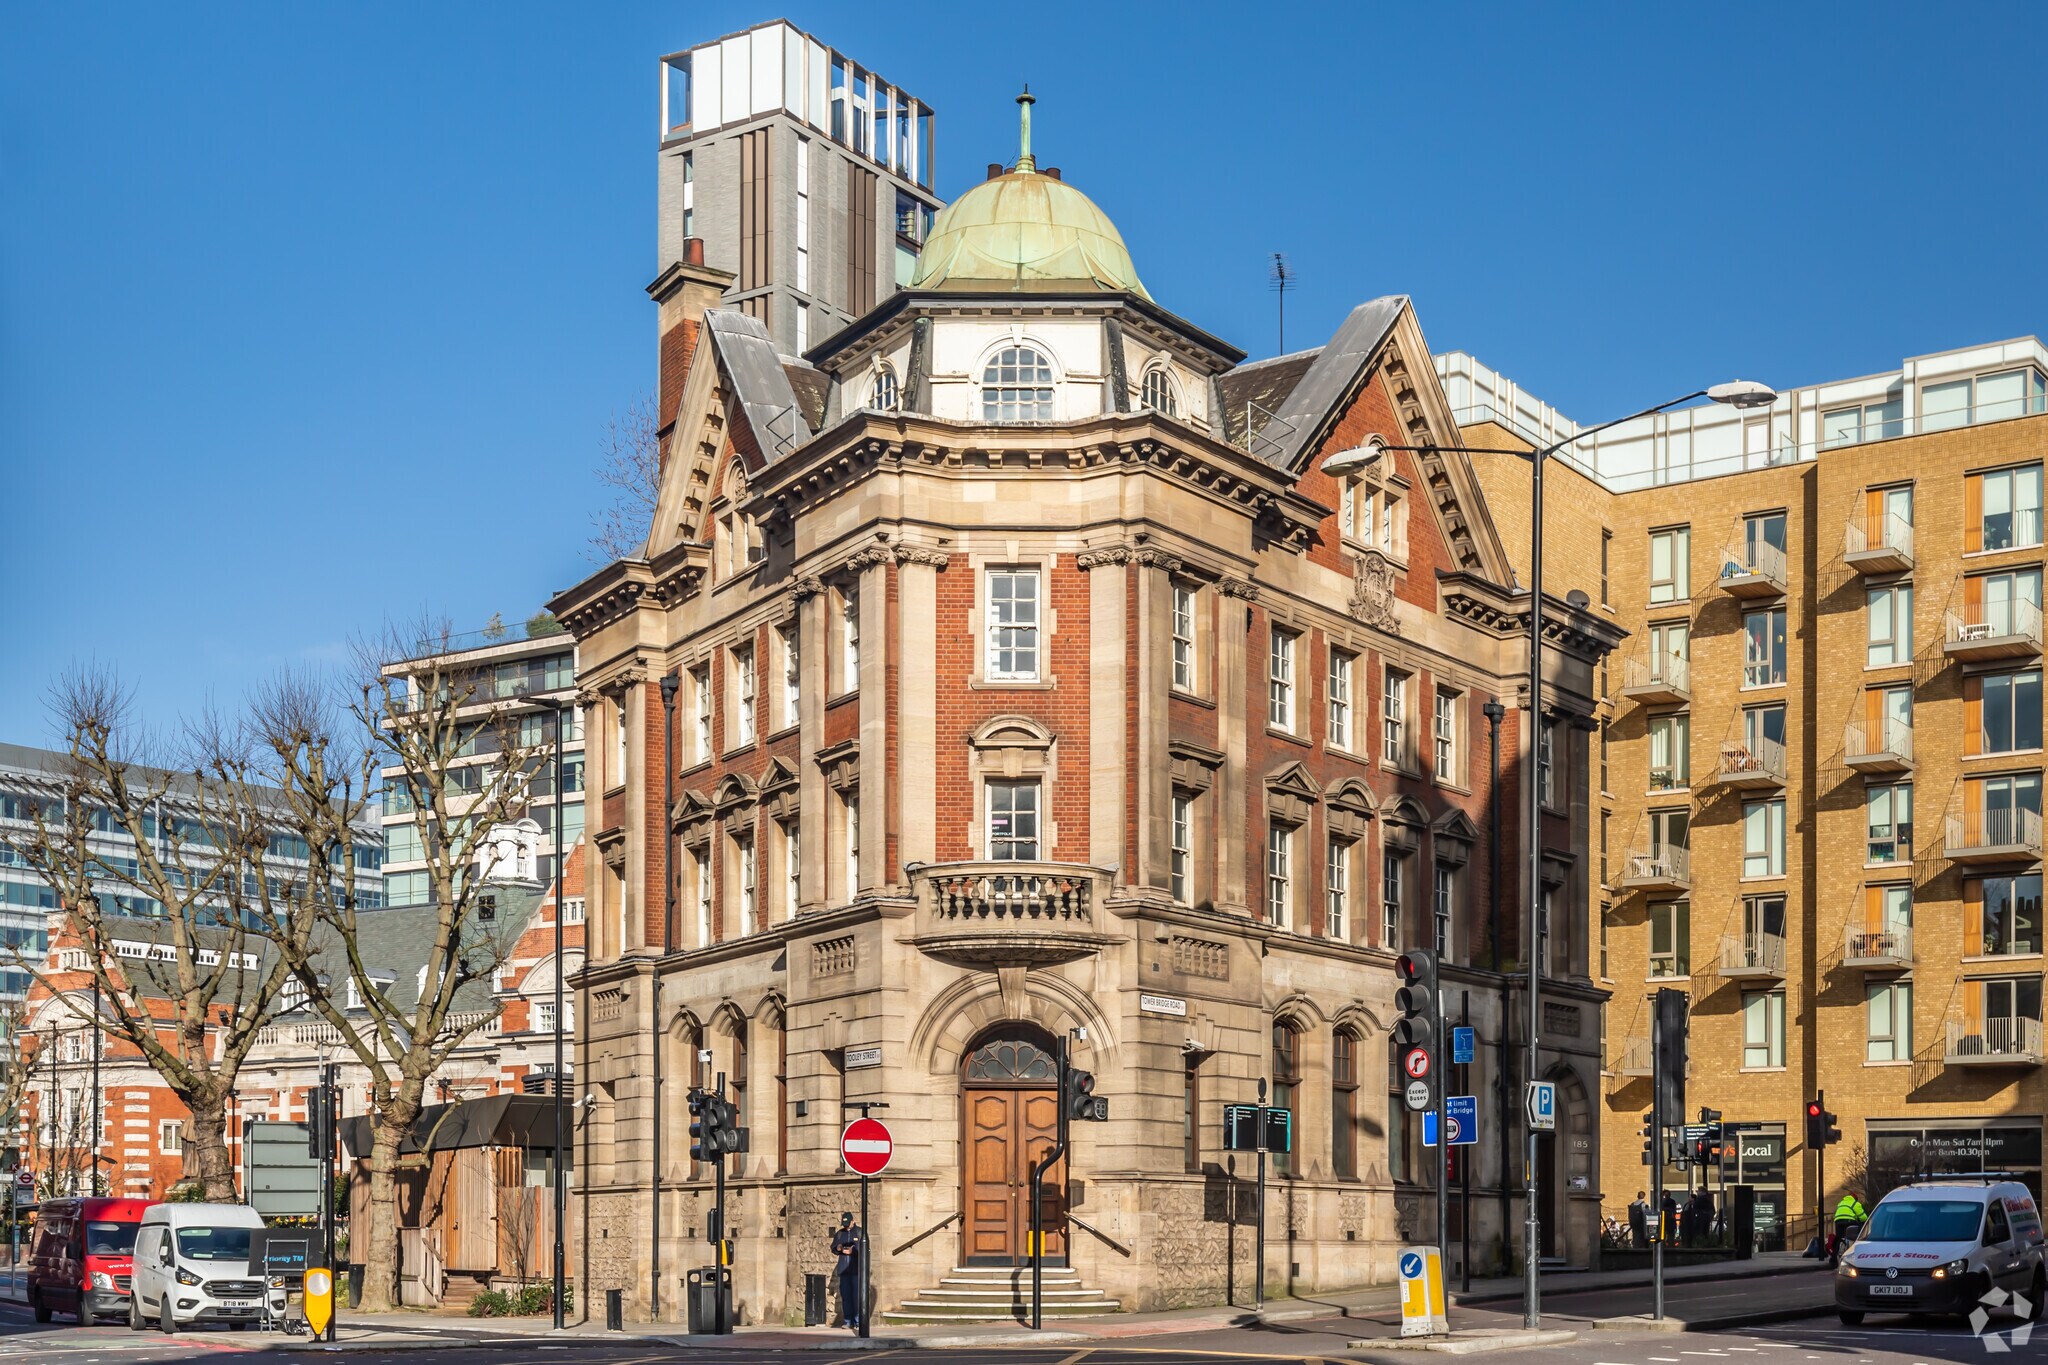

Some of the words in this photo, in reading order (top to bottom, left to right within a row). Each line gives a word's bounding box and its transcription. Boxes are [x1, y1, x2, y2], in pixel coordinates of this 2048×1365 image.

[1142, 996, 1156, 1006] TOWER
[1155, 998, 1170, 1009] BRIDGE
[1169, 1000, 1181, 1010] ROAD
[846, 1052, 862, 1062] TOOLEY
[862, 1050, 877, 1060] STREET
[1573, 1140, 1588, 1148] 185
[1910, 1138, 1931, 1148] Opn
[1741, 1143, 1772, 1157] Local
[1857, 1252, 1891, 1260] Grant
[1903, 1252, 1940, 1260] Stone
